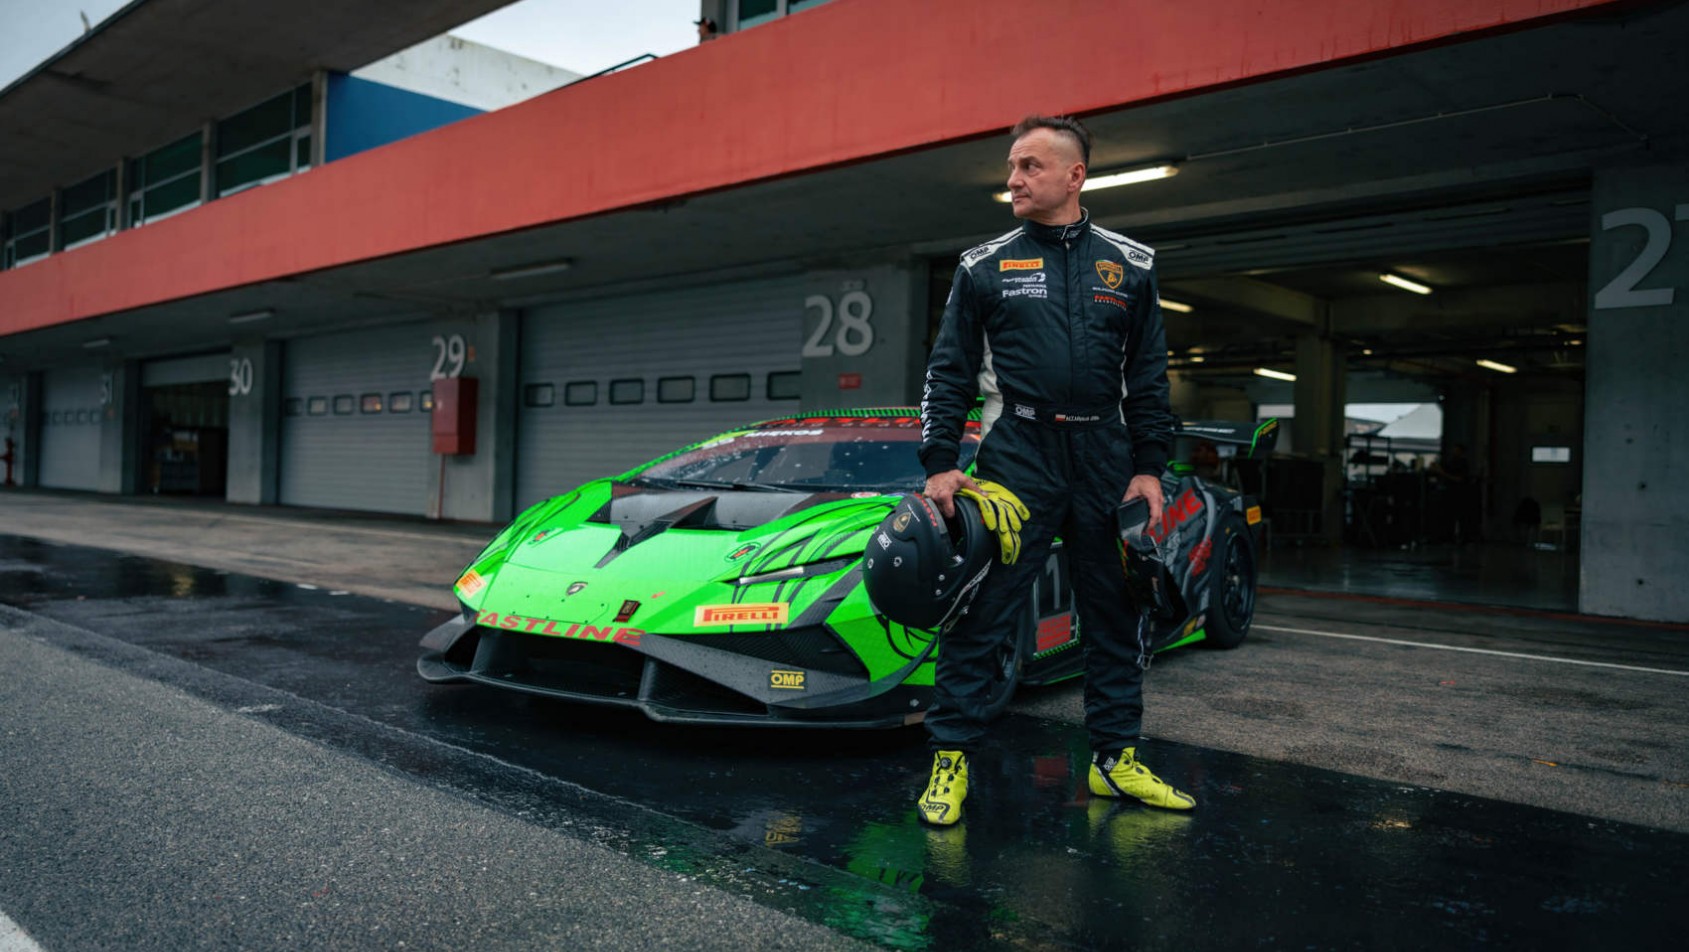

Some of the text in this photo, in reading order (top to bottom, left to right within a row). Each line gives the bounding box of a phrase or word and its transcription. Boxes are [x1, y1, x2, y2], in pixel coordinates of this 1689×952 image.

[970, 246, 990, 261] OMP
[1128, 251, 1150, 264] OMP
[1595, 204, 1689, 309] 2
[1002, 288, 1048, 298] Fastron
[802, 291, 873, 357] 28
[431, 334, 465, 381] 29
[228, 358, 253, 396] 30
[703, 606, 780, 622] PIRELLI
[474, 609, 647, 646] FASTLINE
[770, 673, 805, 687] OMP
